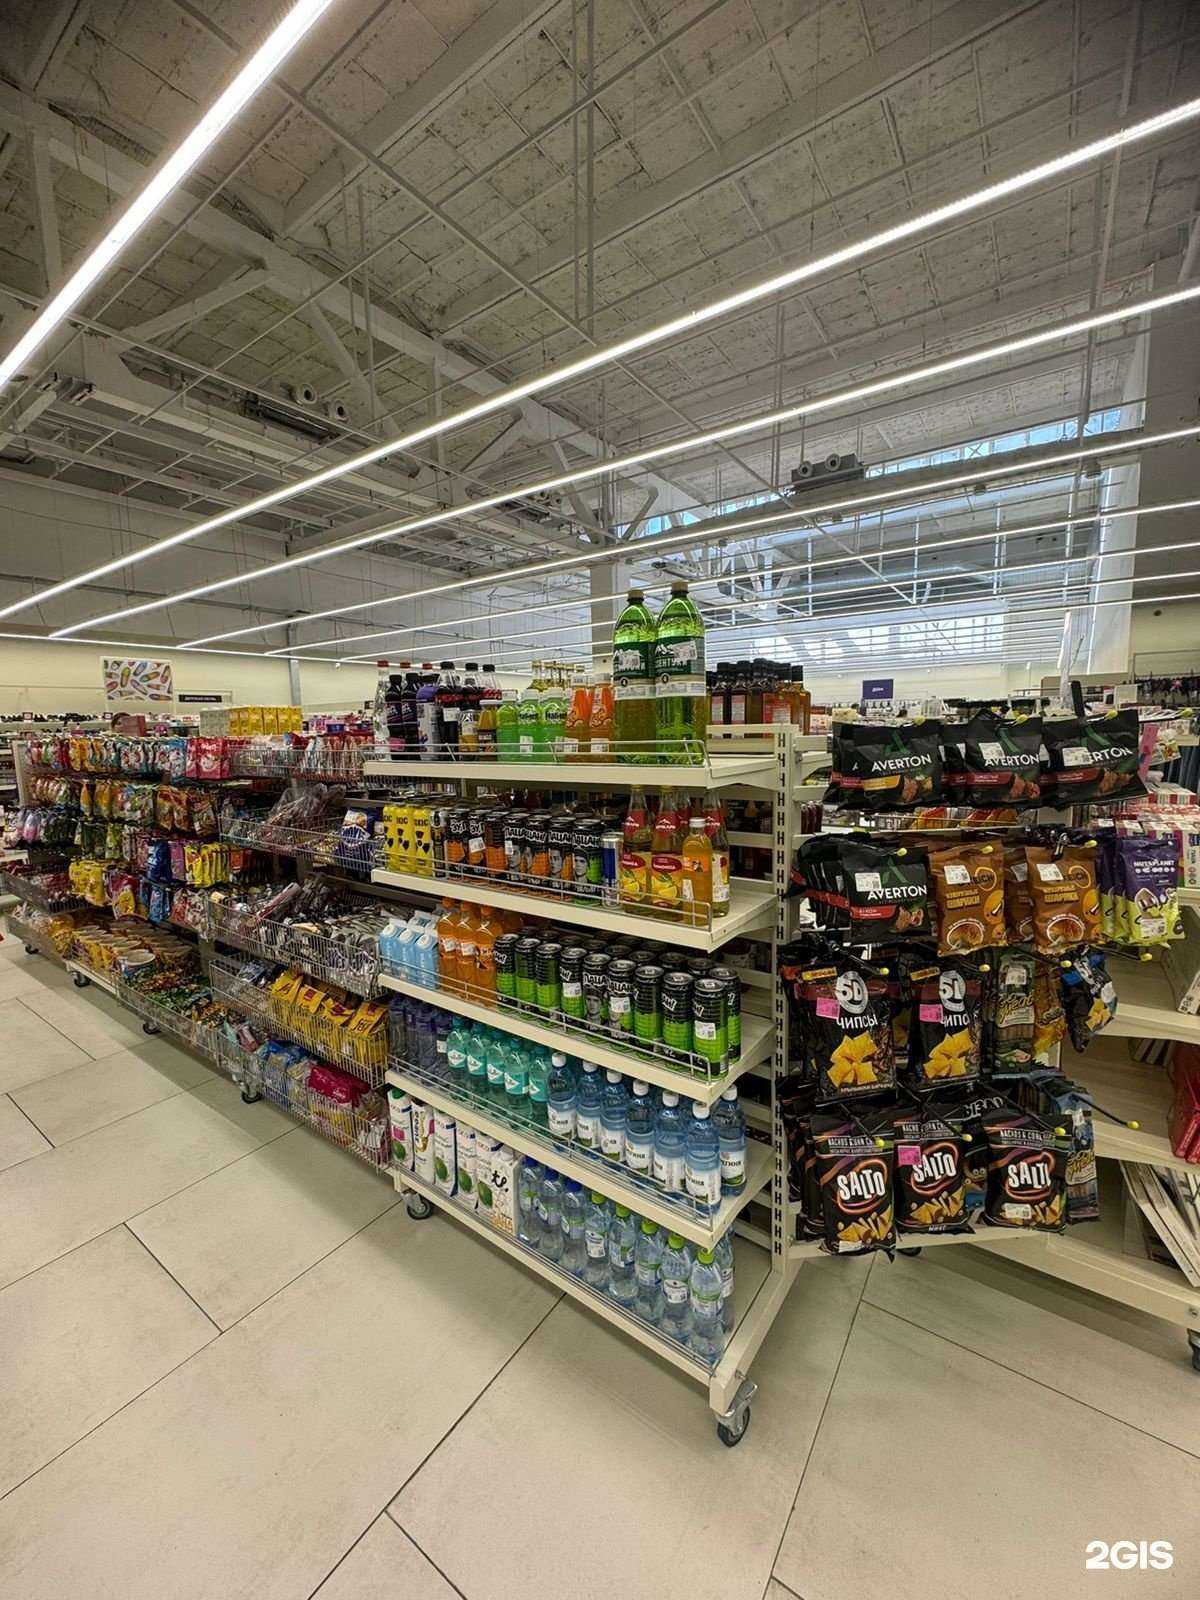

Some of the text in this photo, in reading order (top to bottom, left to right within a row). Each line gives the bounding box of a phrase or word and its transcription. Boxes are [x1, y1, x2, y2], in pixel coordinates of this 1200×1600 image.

[872, 754, 932, 773] AVERTON
[984, 754, 1041, 767] AVERTON
[1088, 746, 1133, 764] ERTON
[867, 885, 928, 901] AVERTON
[837, 1013, 879, 1030] ЧИПСЫ
[912, 1151, 956, 1183] SALTO
[837, 1168, 885, 1201] SALTO
